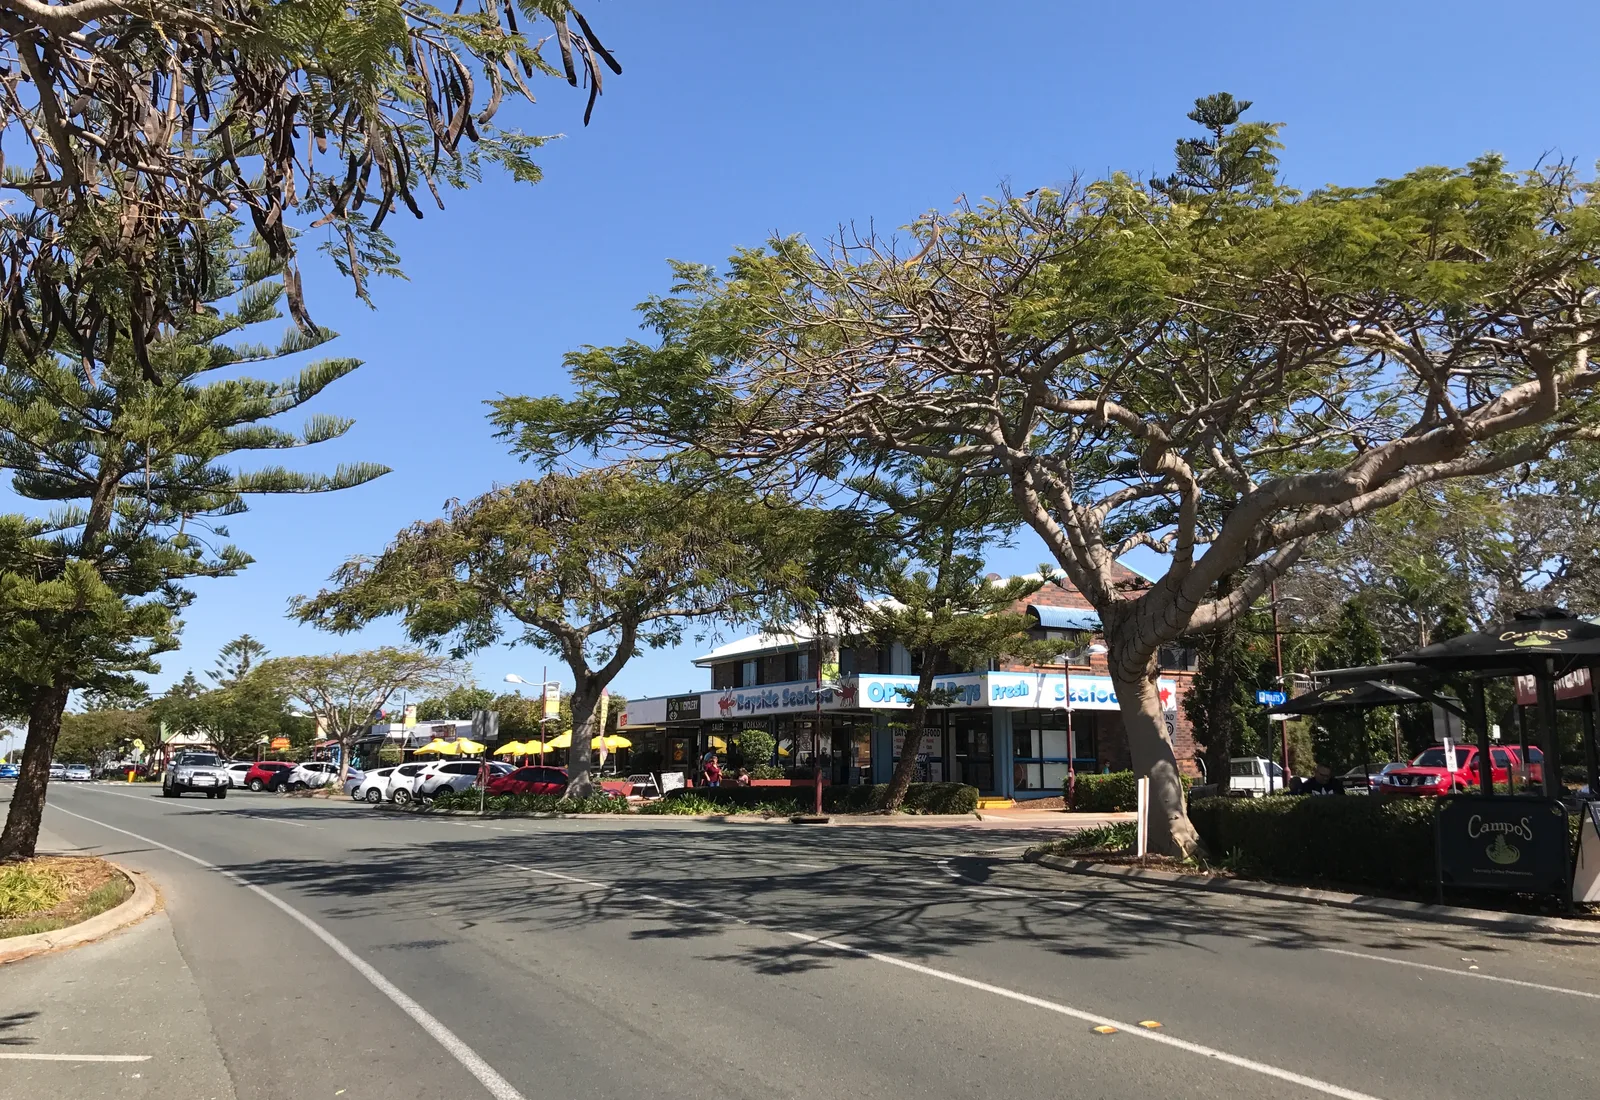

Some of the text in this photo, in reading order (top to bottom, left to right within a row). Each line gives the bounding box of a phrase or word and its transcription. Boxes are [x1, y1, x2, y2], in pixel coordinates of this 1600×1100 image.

[737, 689, 779, 714] Bayside
[992, 680, 1119, 703] Fresh Seafoo
